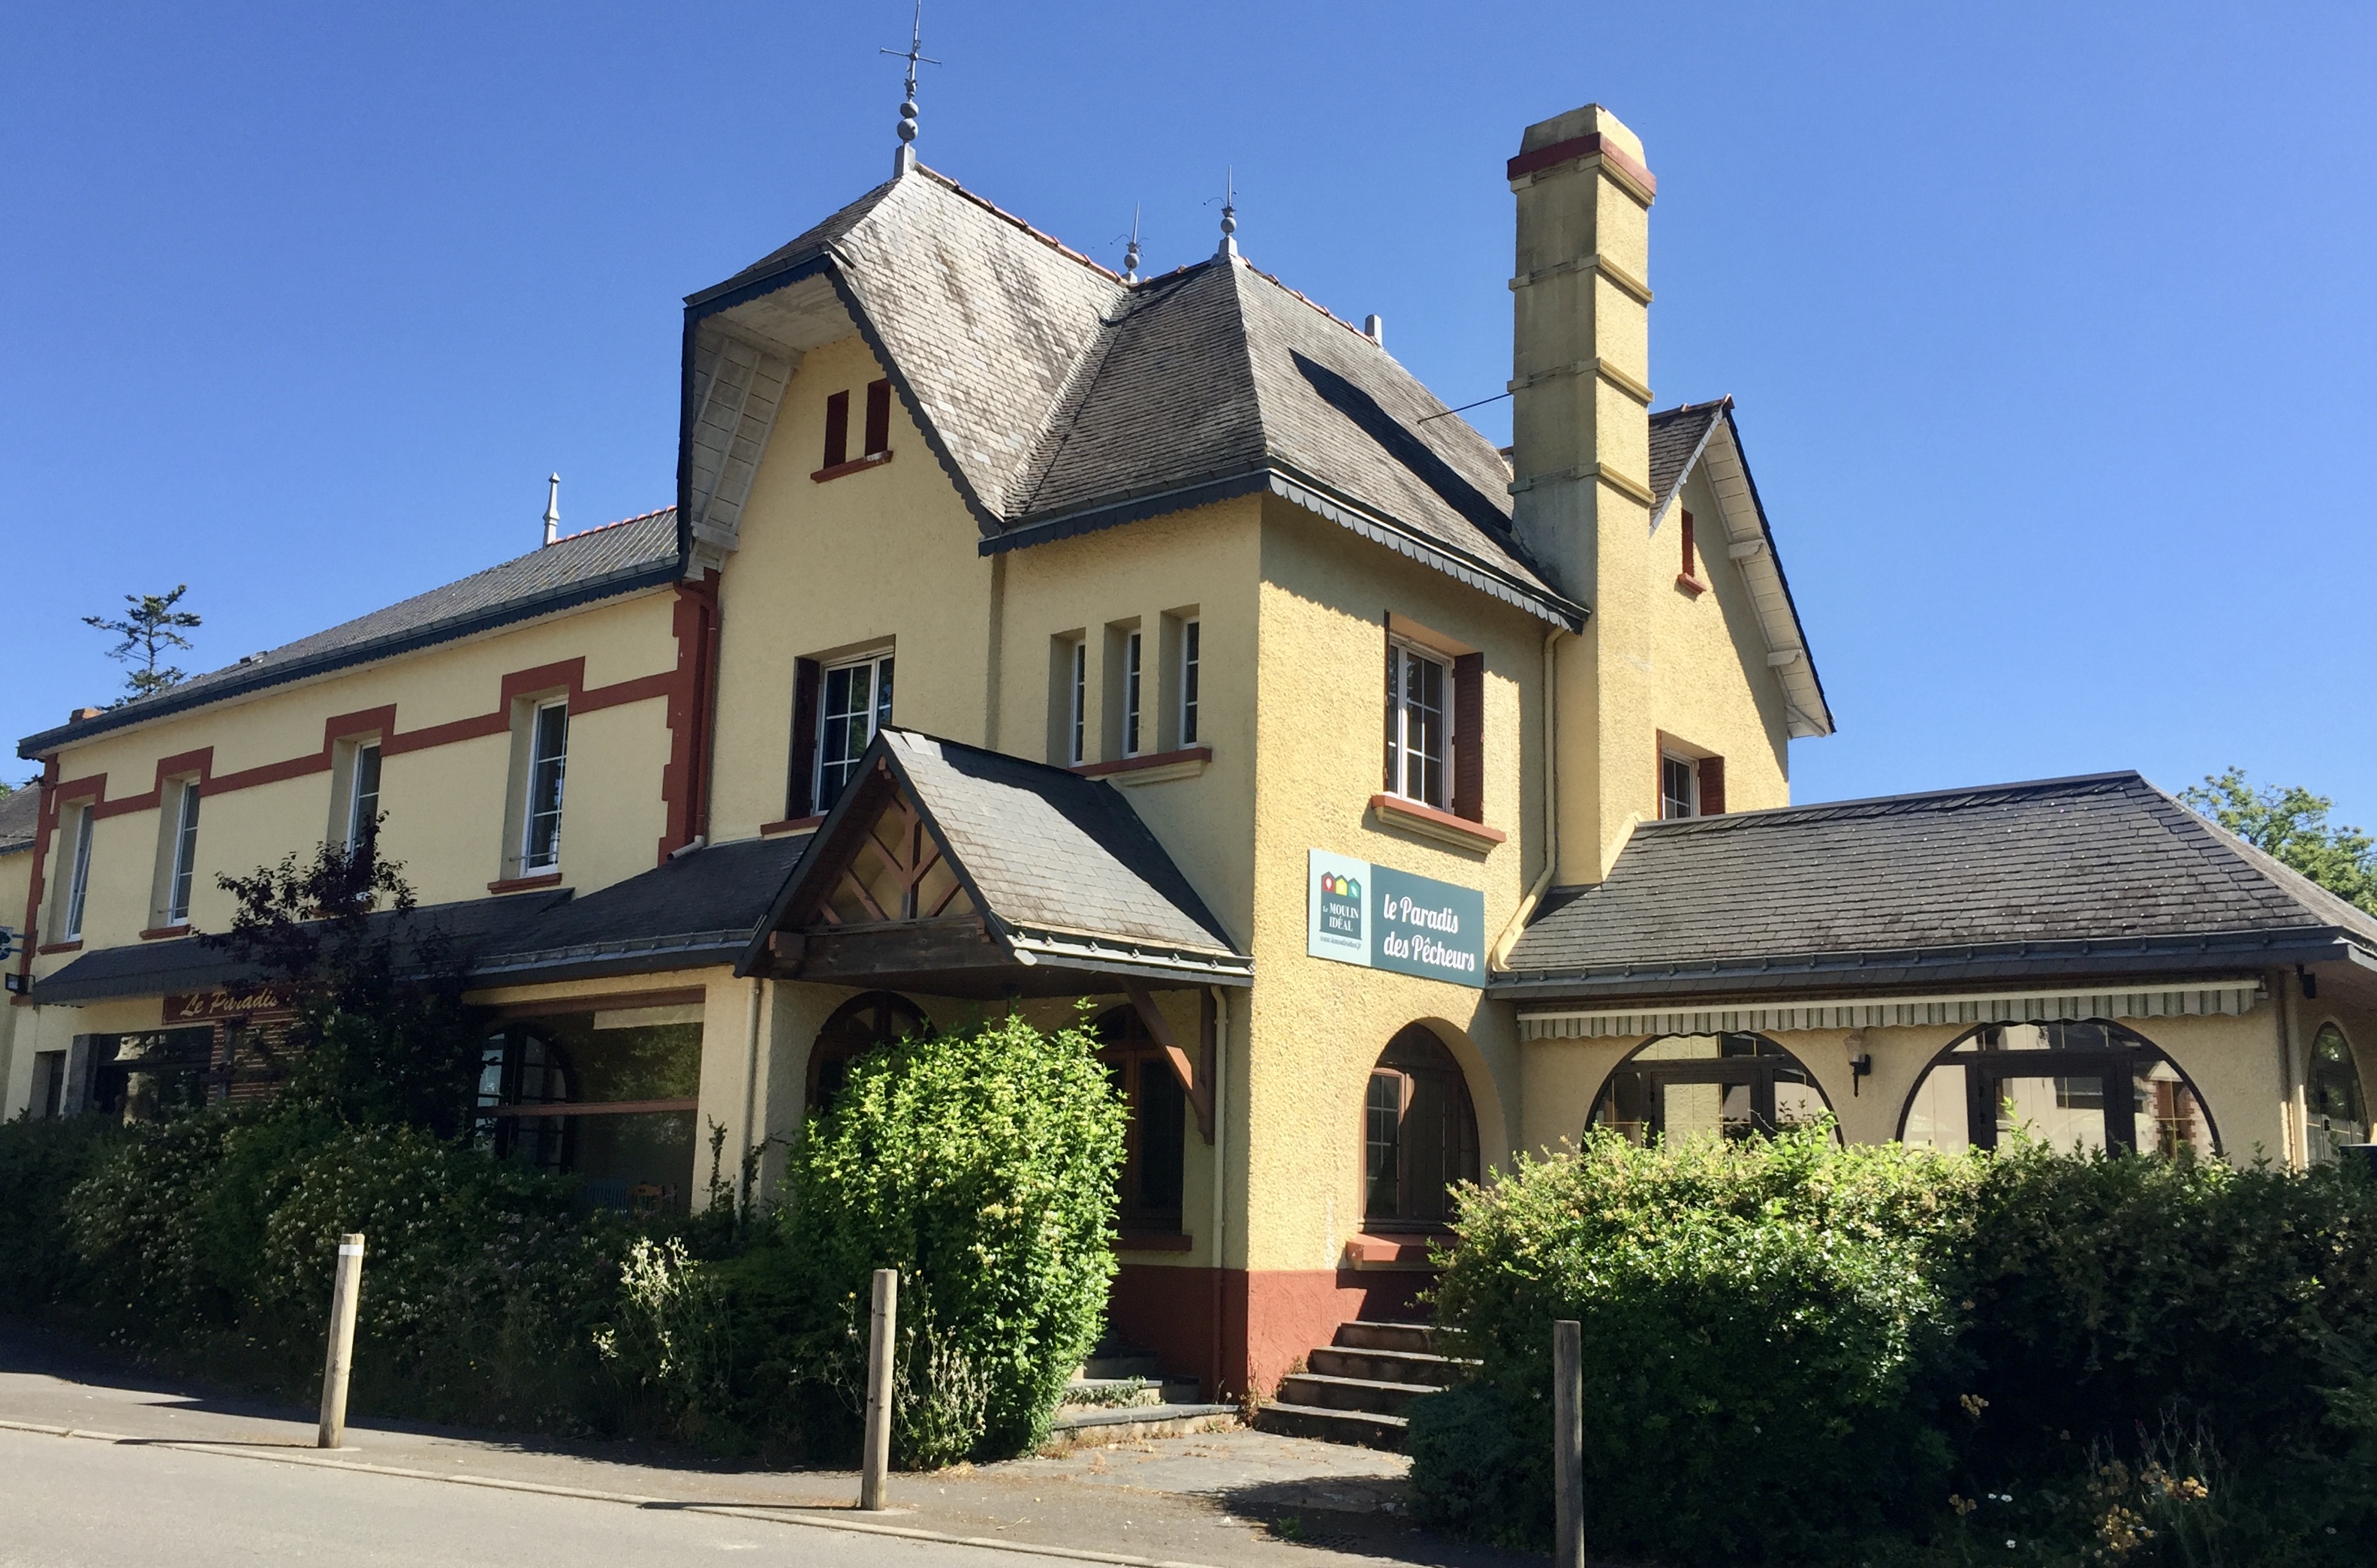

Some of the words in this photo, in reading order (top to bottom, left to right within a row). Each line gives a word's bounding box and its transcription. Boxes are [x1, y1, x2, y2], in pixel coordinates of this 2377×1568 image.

[1329, 902, 1359, 919] MOULIN
[1399, 896, 1459, 934] Paradis
[1329, 916, 1353, 932] IDÉAL
[1383, 931, 1409, 959] des
[1411, 934, 1475, 972] Pêcheurs
[209, 988, 279, 1014] Paradis
